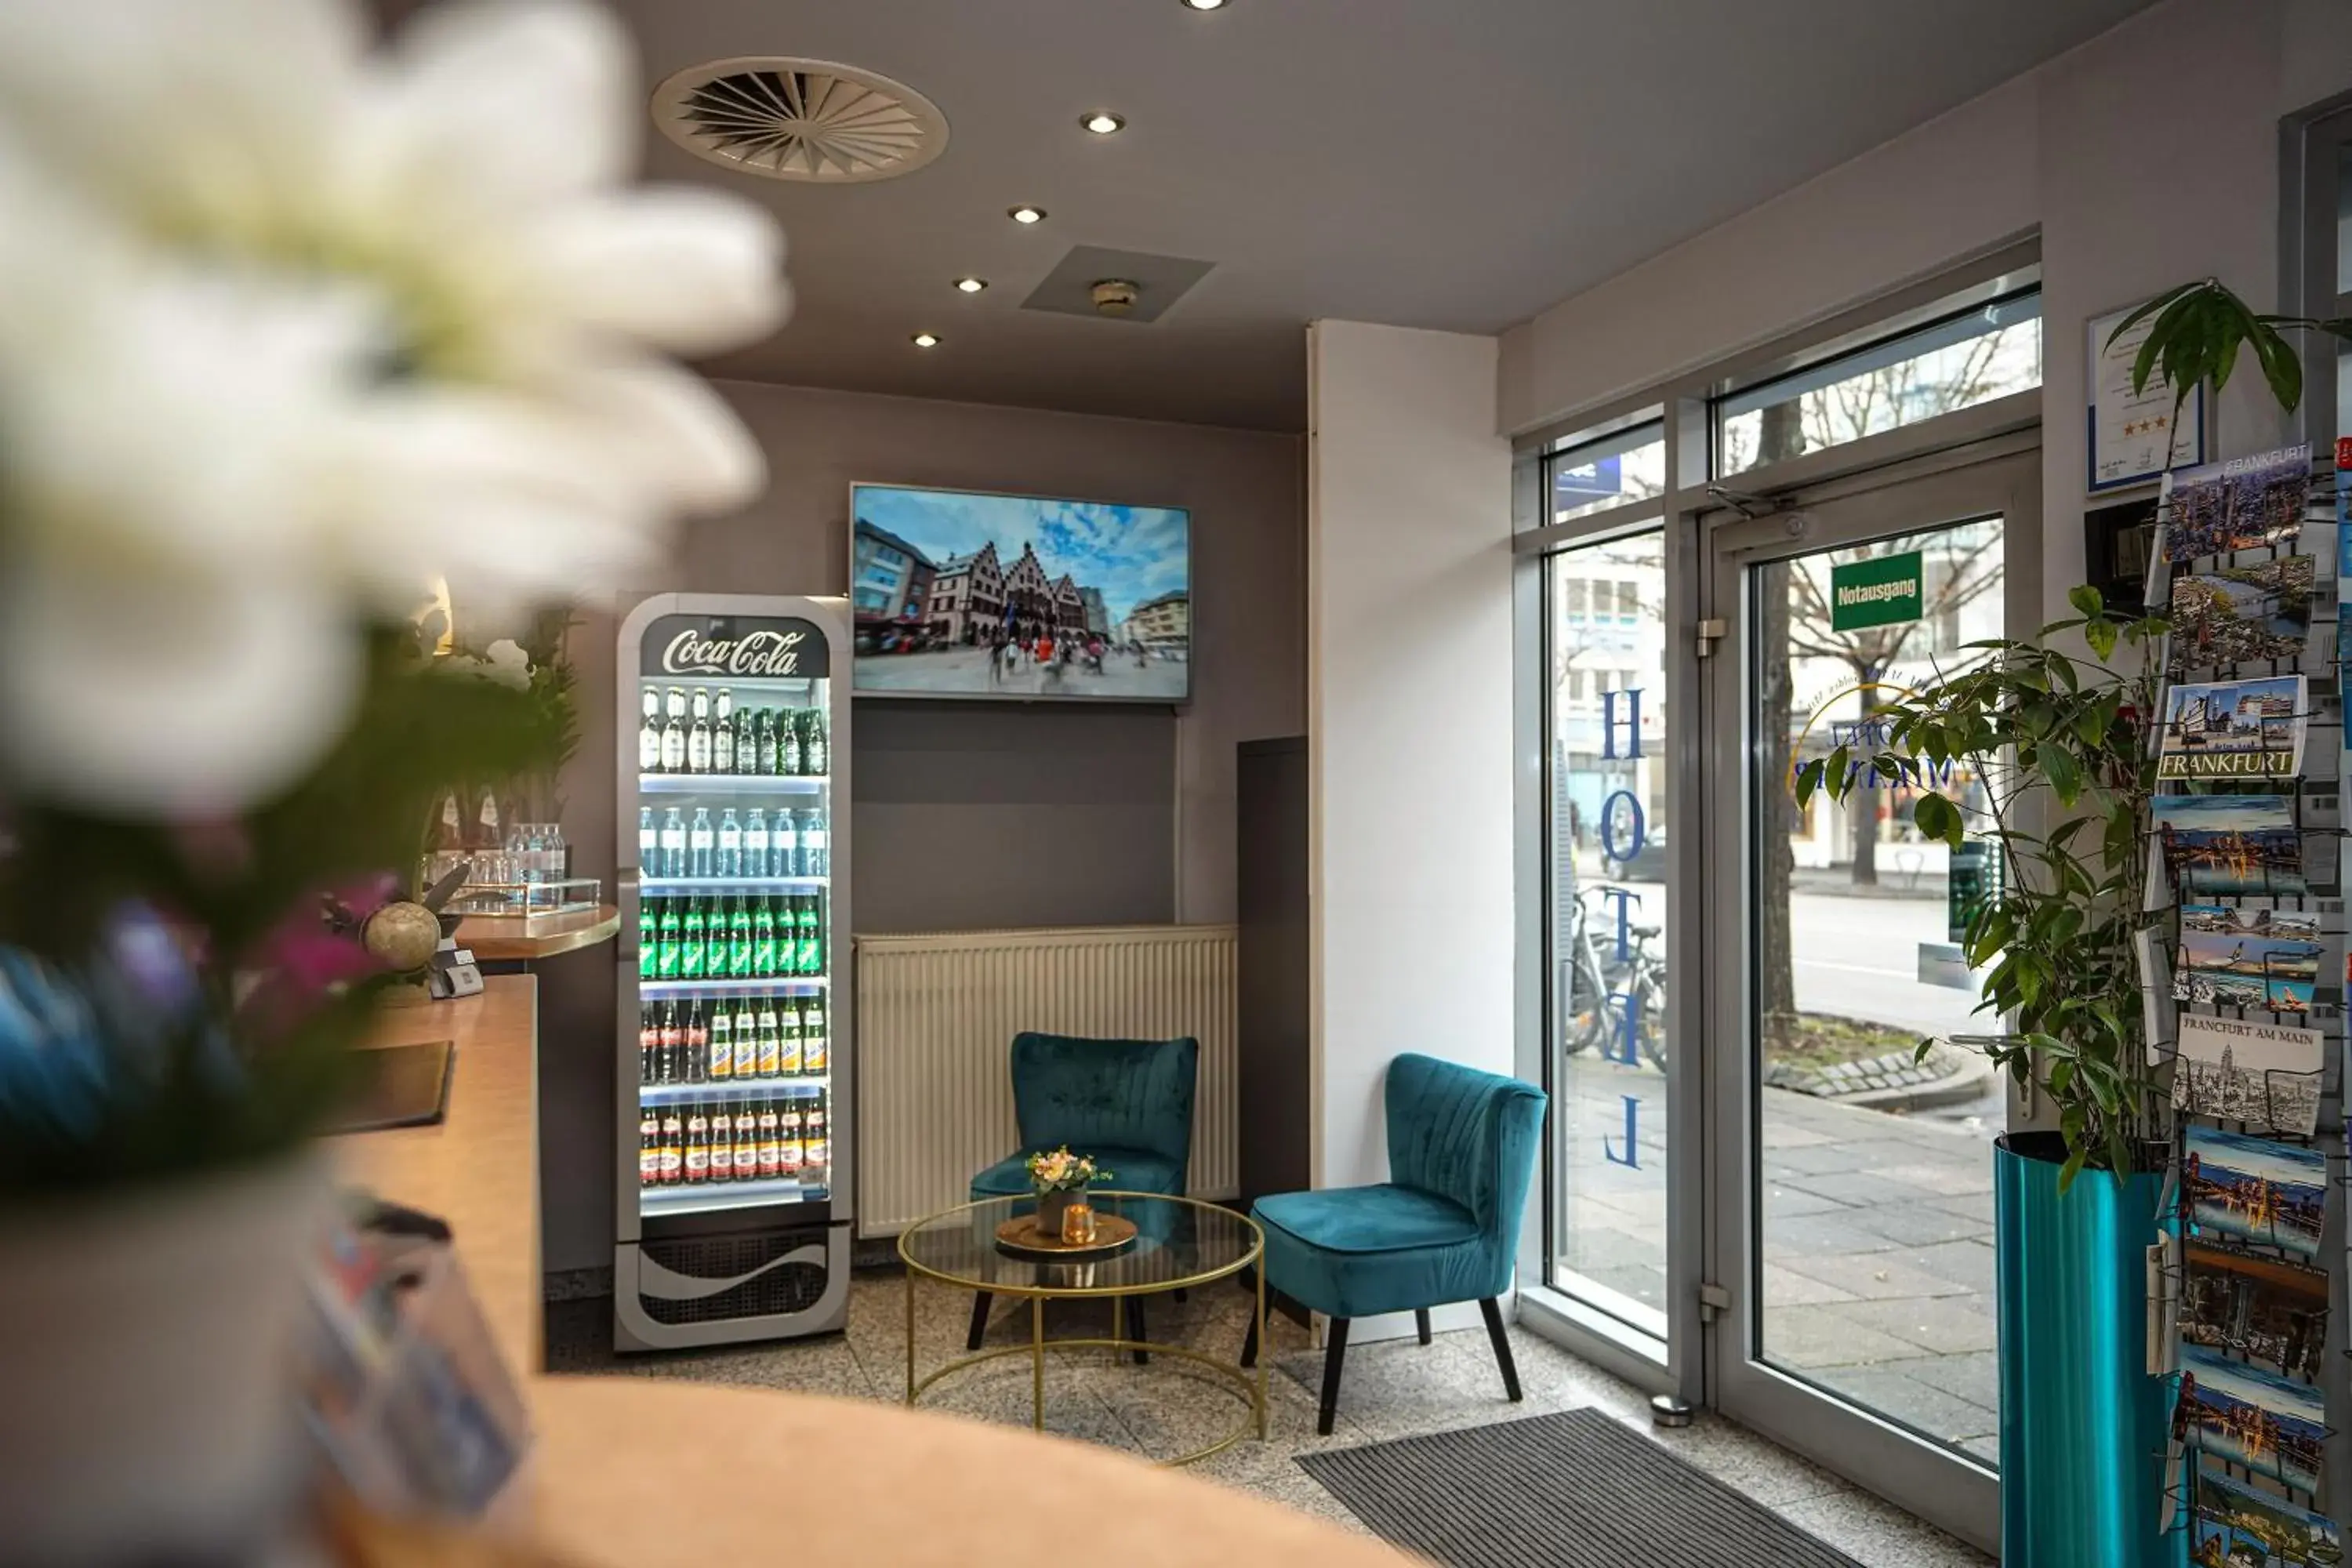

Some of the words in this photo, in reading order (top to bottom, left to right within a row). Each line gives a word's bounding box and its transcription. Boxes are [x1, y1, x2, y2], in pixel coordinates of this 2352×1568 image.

[1838, 578, 1916, 607] Notausgang
[662, 630, 806, 675] Coca-Cola
[2161, 750, 2291, 774] FRANKFURT
[2256, 1028, 2276, 1040] AM
[2279, 1031, 2314, 1045] MAIN
